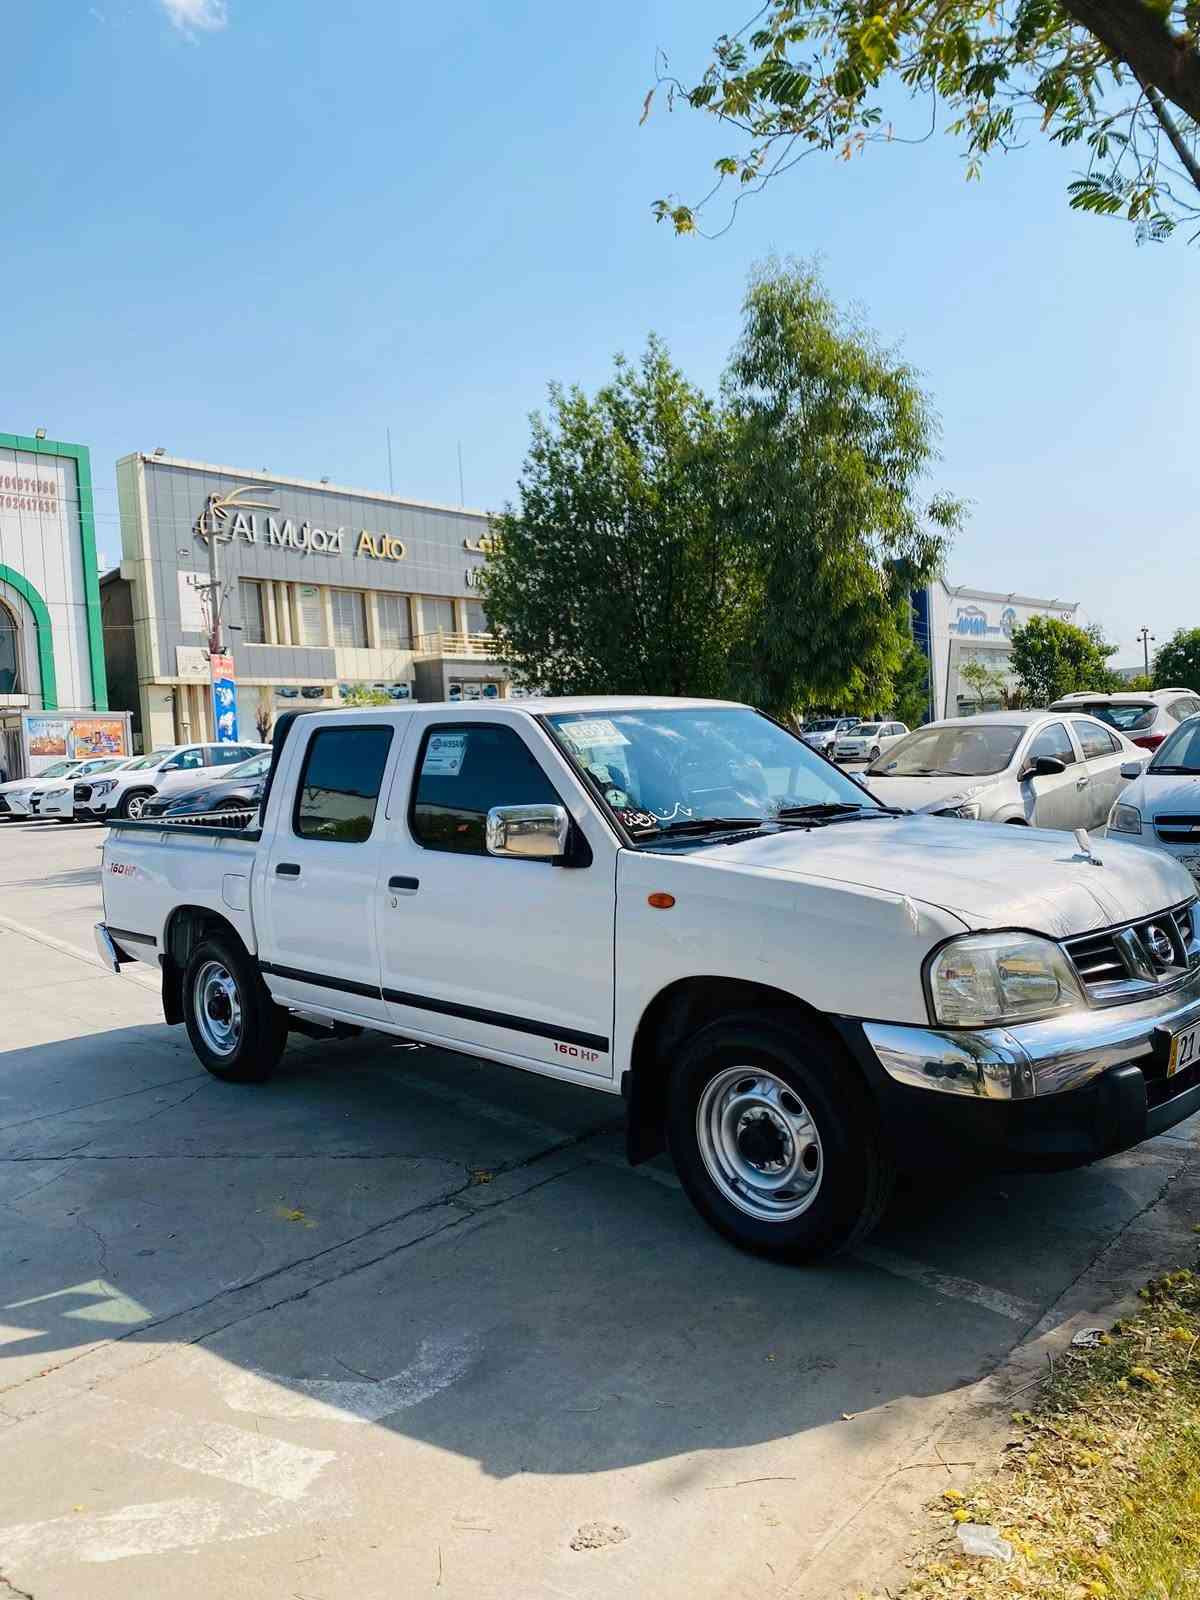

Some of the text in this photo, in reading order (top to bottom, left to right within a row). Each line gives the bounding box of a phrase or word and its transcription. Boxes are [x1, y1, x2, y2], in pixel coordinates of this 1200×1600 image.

[231, 512, 257, 543] Al
[355, 527, 408, 561] Auto
[110, 862, 125, 874] 160
[553, 1042, 600, 1062] 160 HP
[1179, 1031, 1195, 1067] 21
